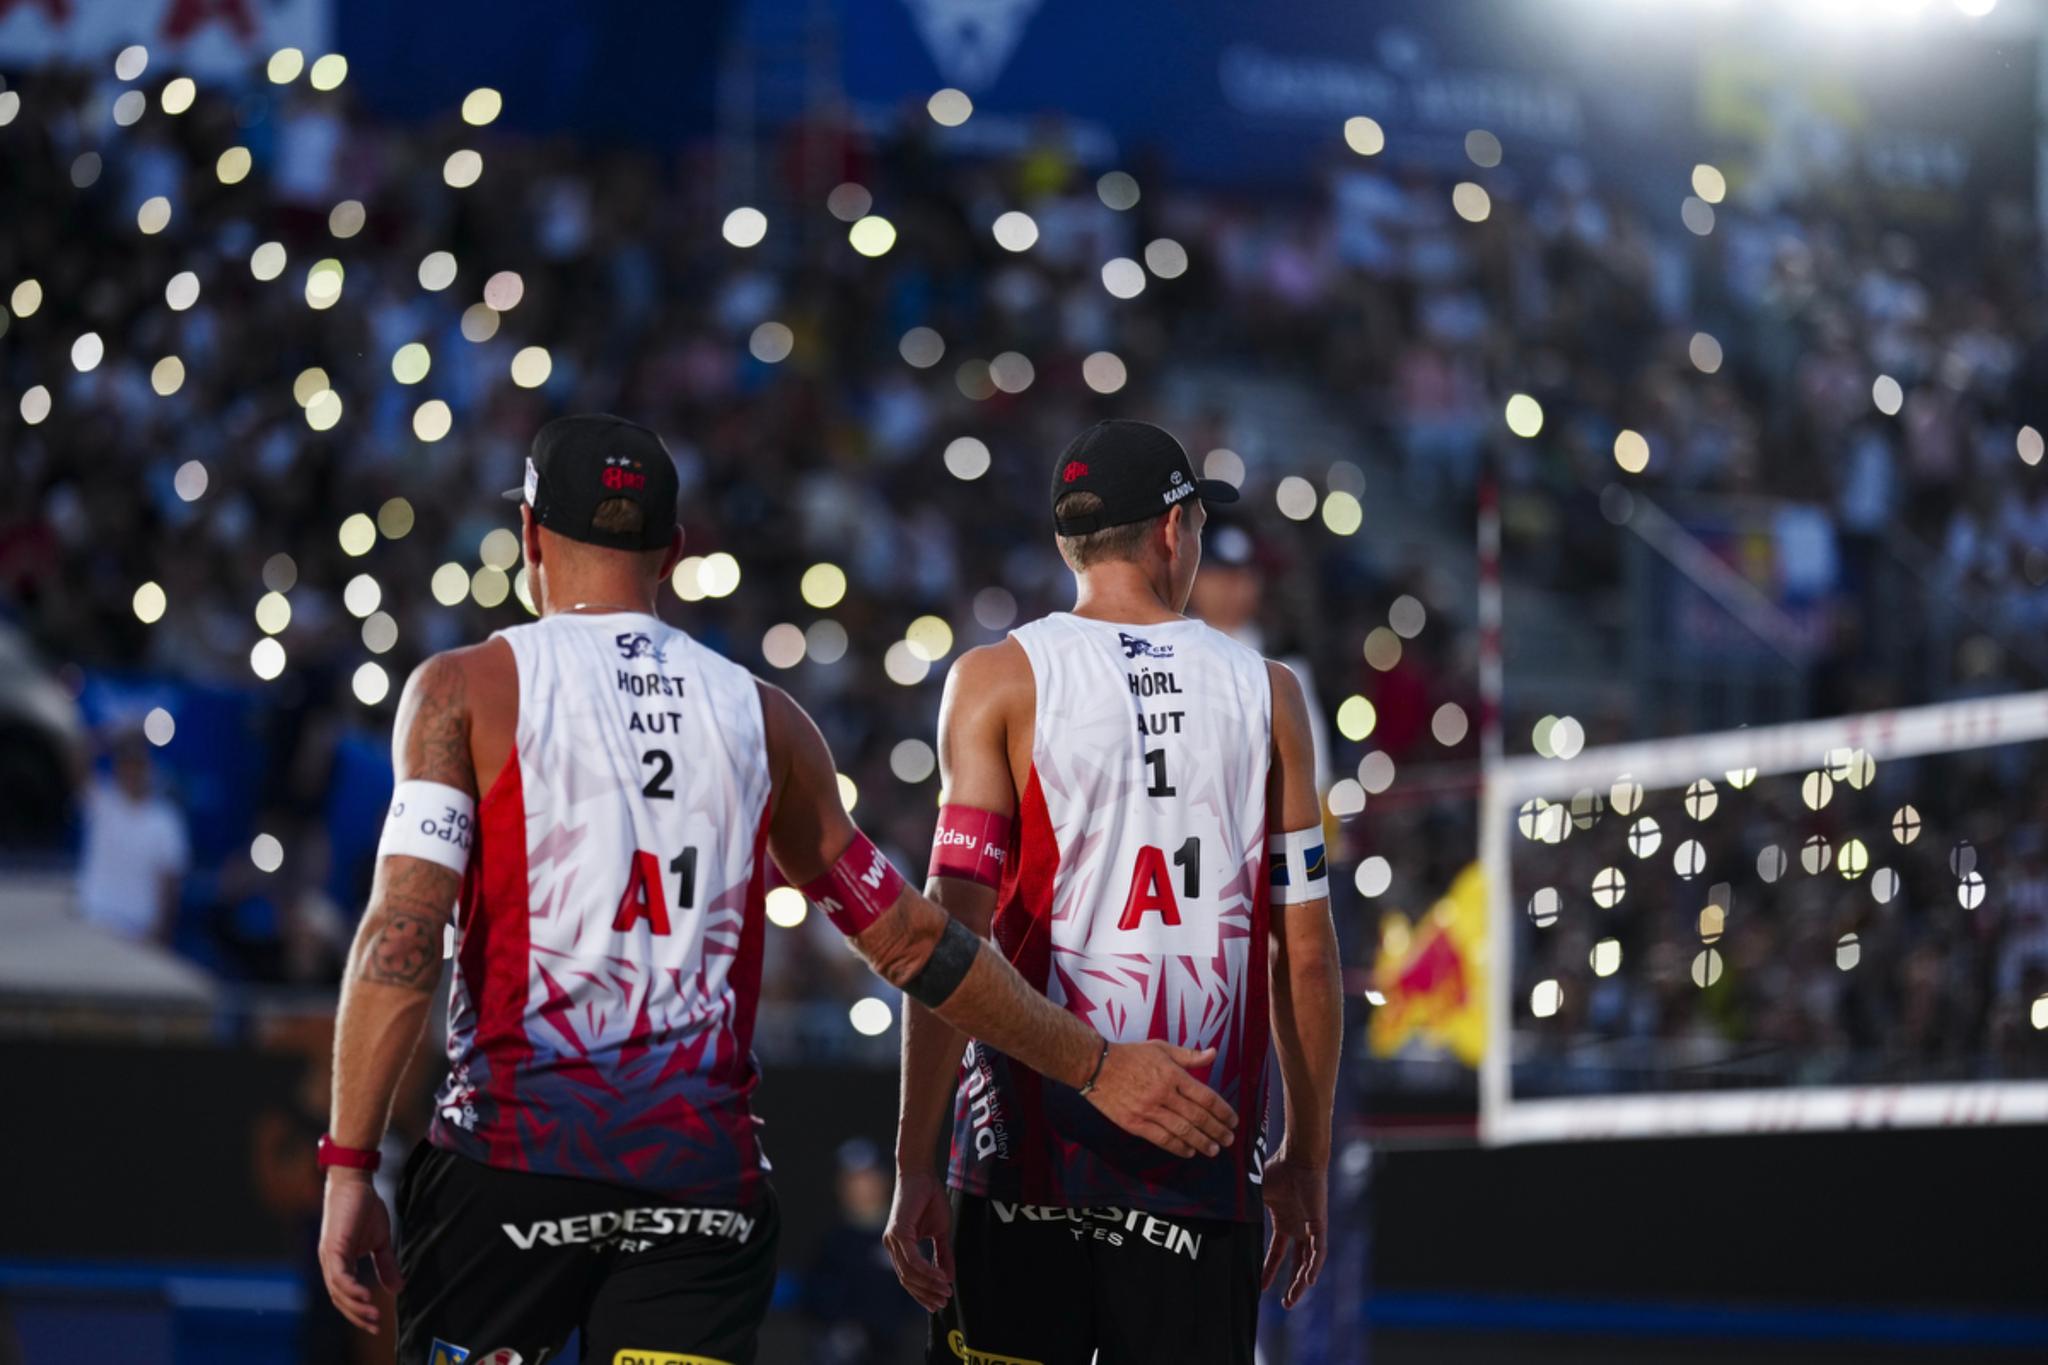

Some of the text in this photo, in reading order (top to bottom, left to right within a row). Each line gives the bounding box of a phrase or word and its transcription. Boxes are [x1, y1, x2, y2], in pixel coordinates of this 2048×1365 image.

[616, 669, 686, 699] HORST
[1128, 667, 1182, 698] HÖRL
[629, 712, 682, 734] AUT
[1137, 711, 1185, 736] AUT
[642, 749, 674, 800] 2
[1144, 748, 1177, 798] 1
[612, 845, 698, 936] A1
[1117, 836, 1201, 931] A1
[501, 1208, 755, 1250] VREDESTEIN
